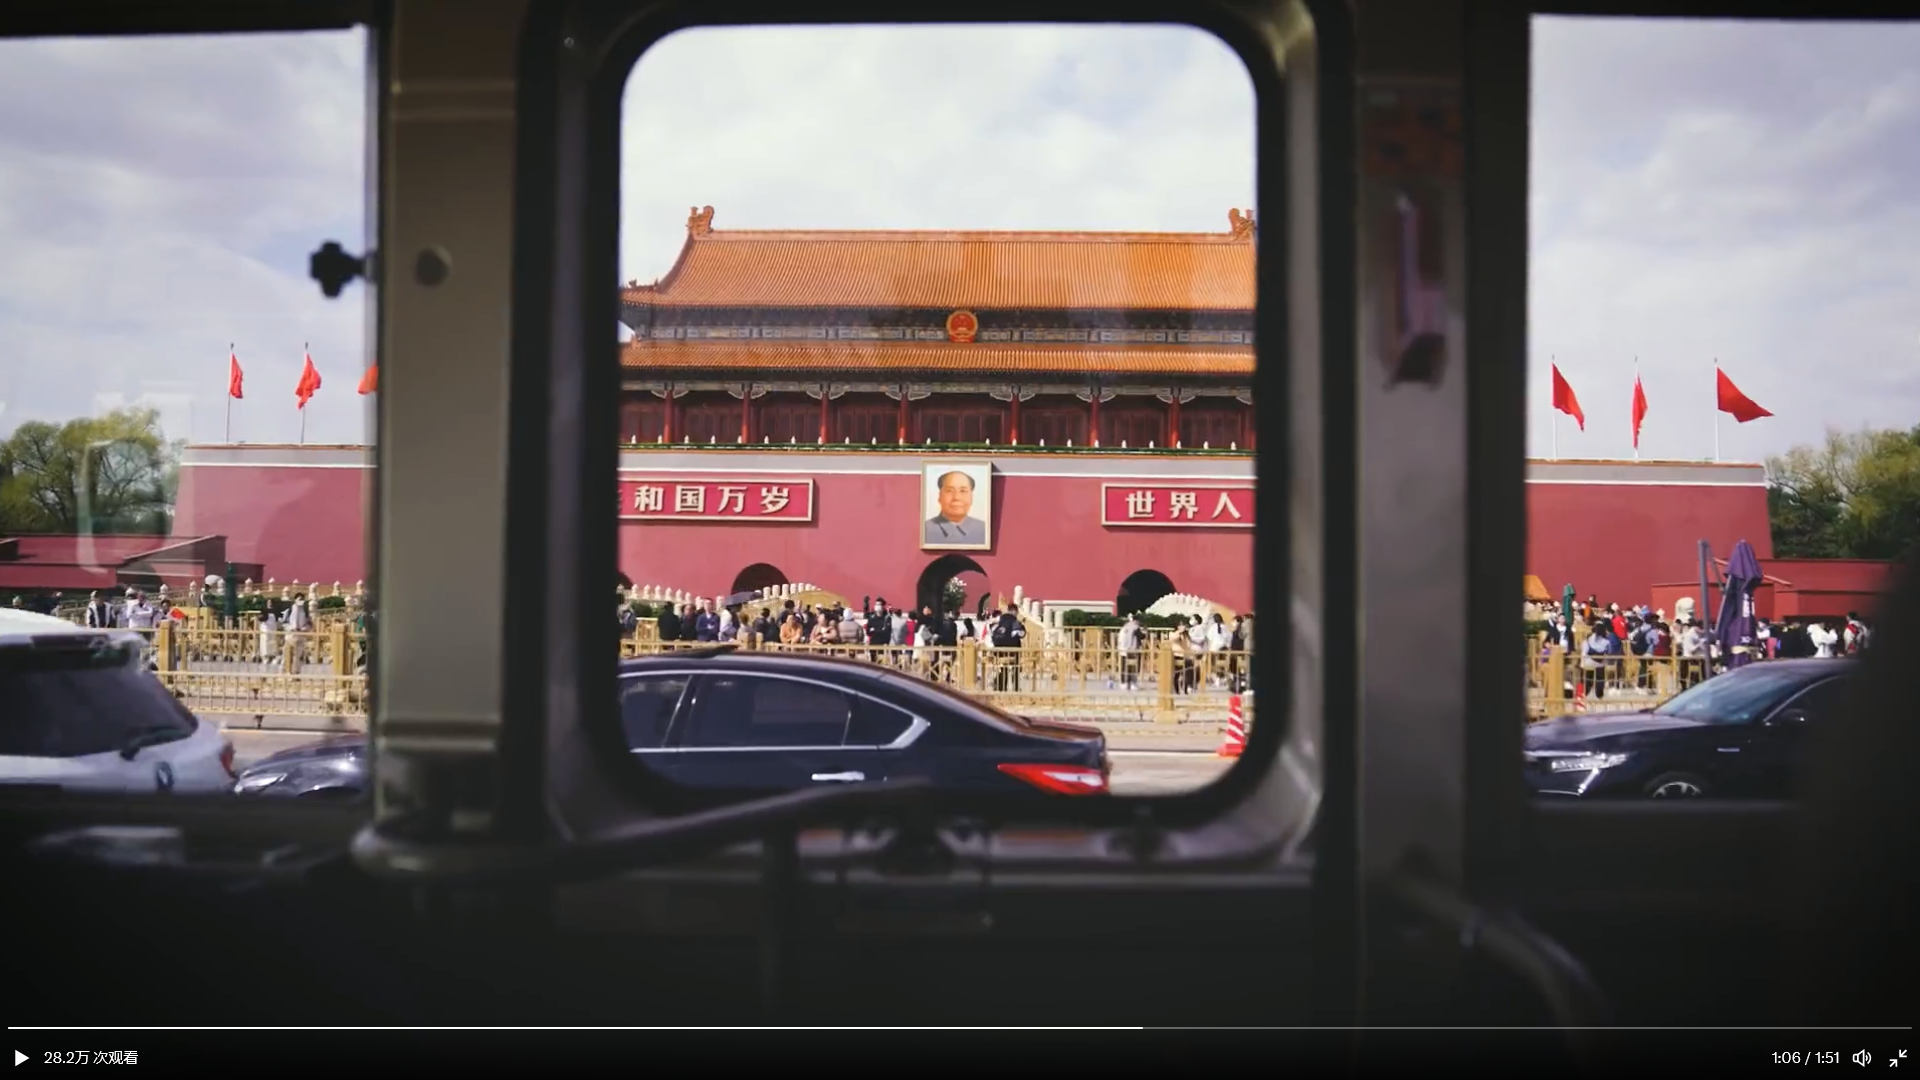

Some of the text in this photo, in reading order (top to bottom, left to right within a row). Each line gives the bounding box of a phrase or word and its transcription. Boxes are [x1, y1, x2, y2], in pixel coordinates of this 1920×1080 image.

[617, 484, 790, 514] 和国万岁
[1125, 490, 1242, 520] 世界人
